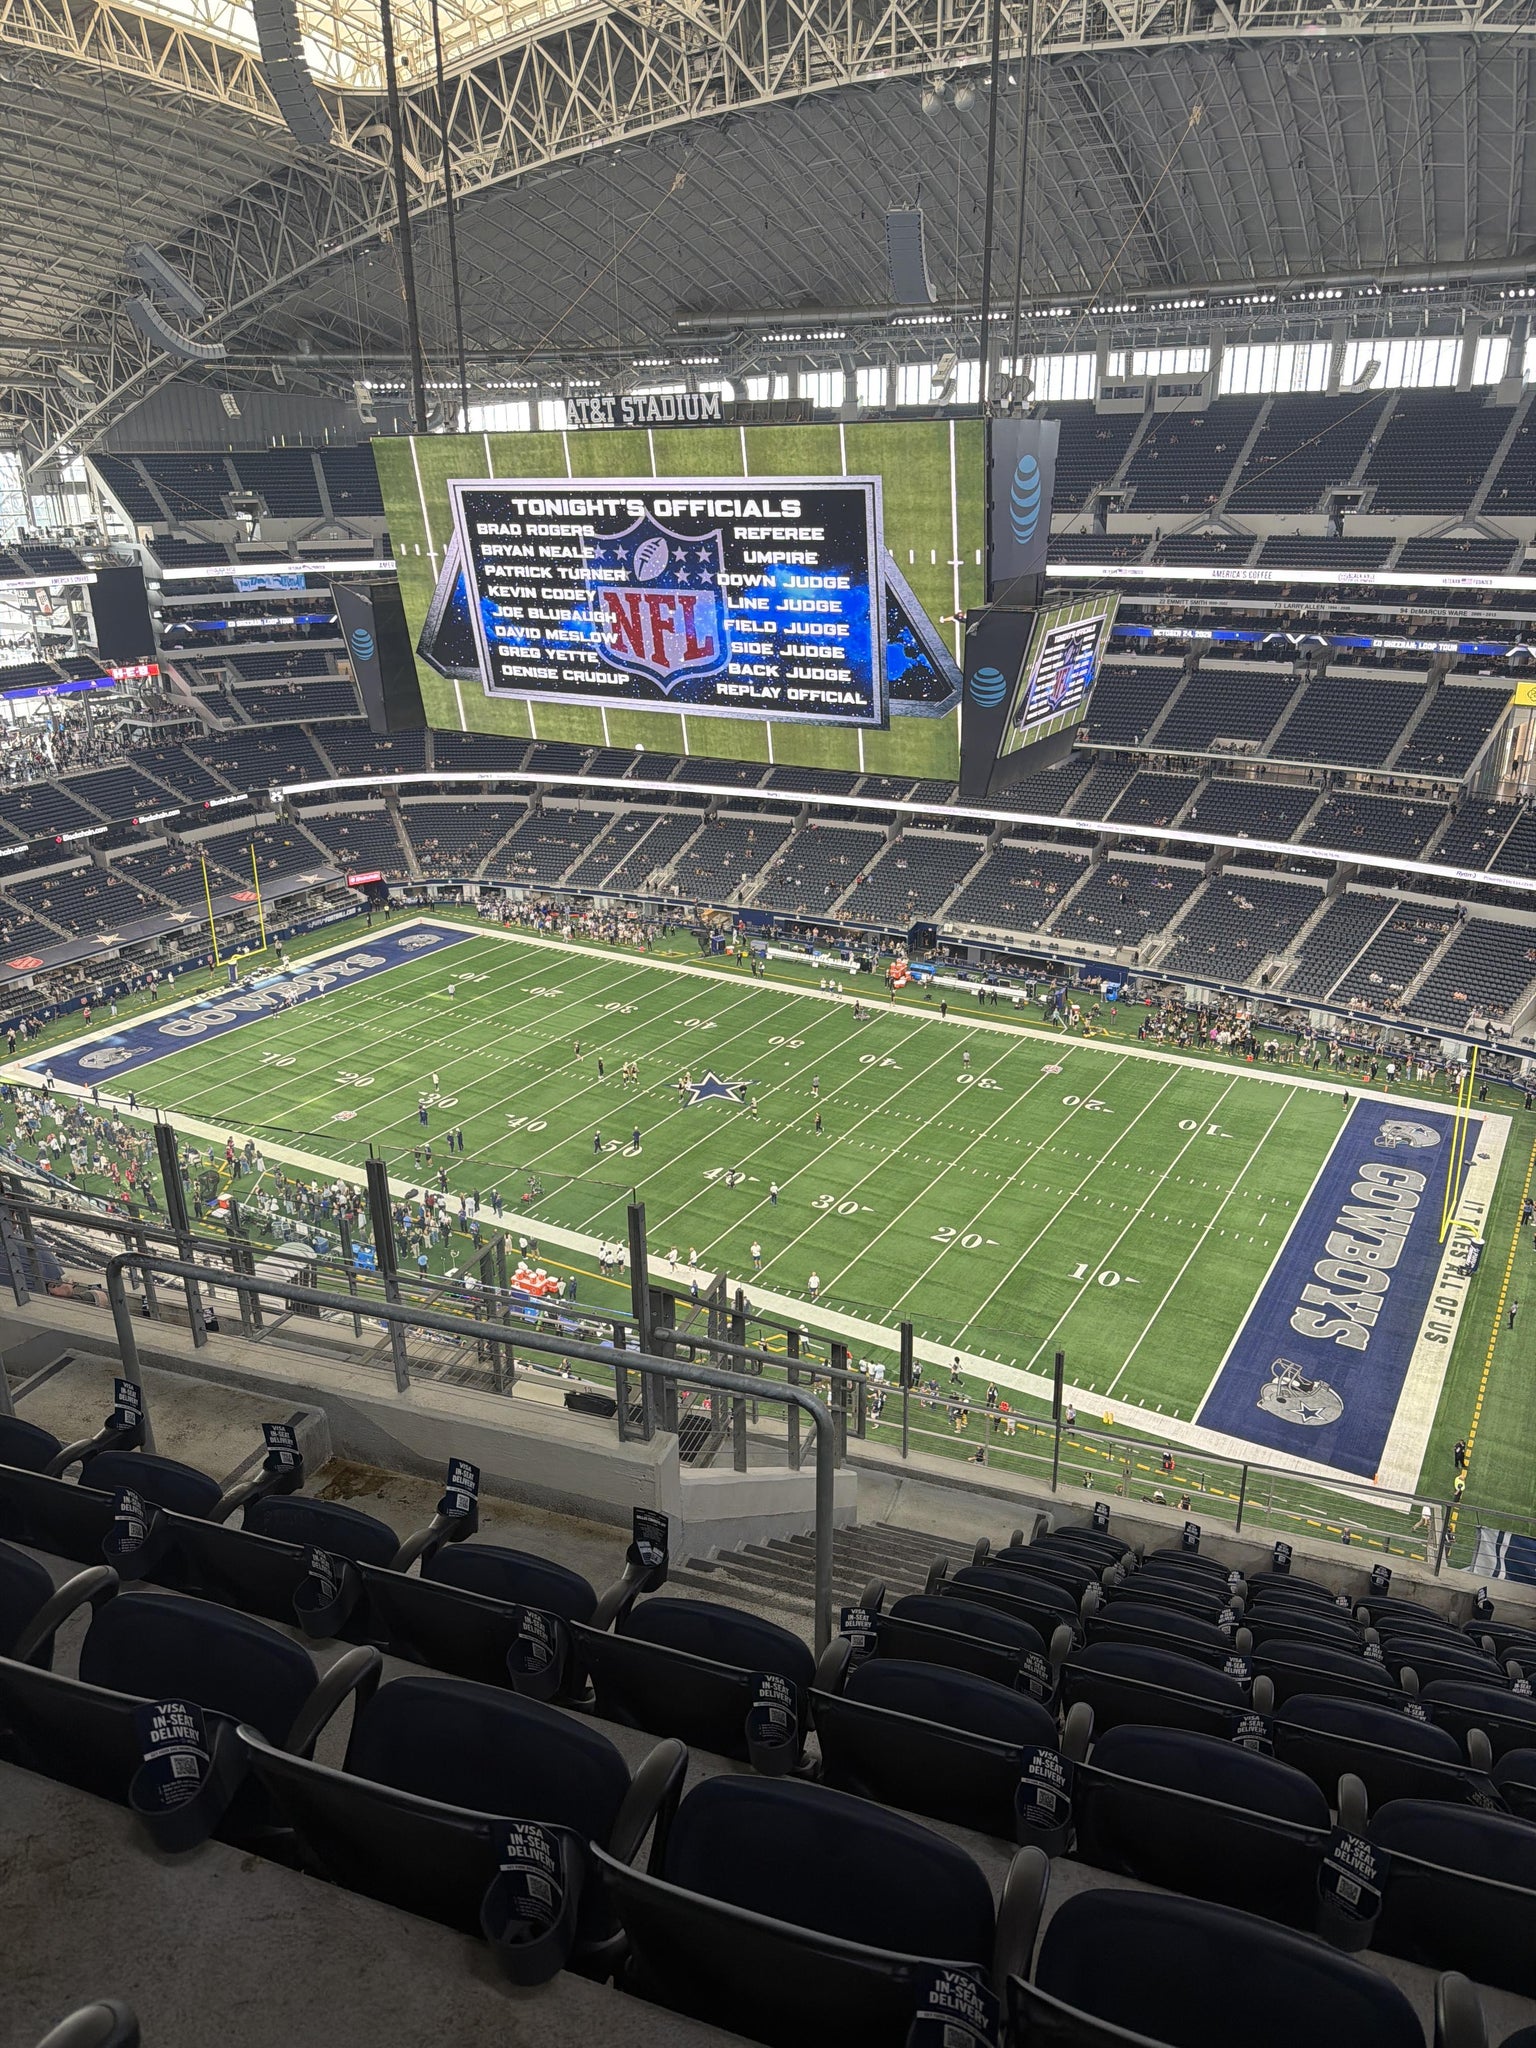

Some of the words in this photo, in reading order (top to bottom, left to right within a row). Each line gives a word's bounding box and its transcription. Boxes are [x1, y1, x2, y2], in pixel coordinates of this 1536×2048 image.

[567, 397, 616, 424] AT&T
[621, 393, 722, 423] STADIUM
[511, 498, 646, 517] TONIGHT'S
[653, 498, 802, 518] OFFICIALS
[477, 523, 521, 536] BRAD
[526, 524, 595, 537] ROGERS
[734, 526, 825, 541] REFEREE
[480, 544, 534, 557] BRYAN
[539, 545, 595, 559] NEALE
[743, 550, 819, 565] UMPIRE
[484, 565, 553, 579] PATRICK
[557, 567, 628, 582] TURNER
[717, 573, 776, 588] DOWN
[783, 576, 851, 590] JUDGE
[1249, 570, 1273, 580] COFFEE
[487, 585, 538, 599] KEVIN
[541, 587, 597, 601] CODEY
[727, 597, 770, 610] LINE
[776, 599, 843, 613] JUDGE
[1190, 599, 1208, 607] SMITH
[492, 606, 523, 619] JOE
[527, 608, 618, 624] BLUBAUGH
[1448, 609, 1468, 617] WARE
[494, 625, 542, 640] DAVID
[545, 627, 619, 644] MESLOW
[602, 591, 715, 669] NFL
[723, 619, 776, 633] FIELD
[783, 622, 850, 637] JUDGE
[1153, 629, 1181, 638] OCTOBER
[498, 645, 541, 659] GREG
[545, 648, 599, 663] YETTE
[730, 641, 774, 655] SIDE
[780, 644, 846, 659] JUDGE
[1418, 642, 1437, 651] LOOP
[1438, 643, 1458, 652] TOUR
[502, 664, 559, 680] DENISE
[562, 670, 630, 685] CRUDUP
[728, 662, 780, 678] BACK
[785, 666, 852, 682] JUDGE
[716, 683, 781, 699] REPLAY
[787, 688, 868, 705] OFFICIAL
[159, 953, 386, 1037] COWBOYS
[1062, 1095, 1107, 1111] 20
[1178, 1119, 1223, 1136] 10
[811, 1194, 861, 1216] 30
[1462, 1200, 1485, 1215] IT
[930, 1226, 984, 1250] 20
[1290, 1163, 1427, 1351] COWBOYS
[1067, 1263, 1121, 1288] 10
[1433, 1296, 1459, 1318] OF
[1424, 1320, 1453, 1345] US
[269, 1436, 294, 1445] DELIVERY
[459, 1462, 472, 1472] VISA
[452, 1474, 476, 1489] DELIVERY
[845, 1620, 872, 1628] DELIVERY
[848, 1614, 870, 1622] IN-SEAT
[761, 1681, 790, 1695] IN-SEAT
[764, 1674, 785, 1685] VISA
[759, 1688, 793, 1706] DELIVERY
[155, 1703, 187, 1715] VISA
[152, 1713, 194, 1729] IN-SEAT
[1239, 1720, 1265, 1728] IN-SEAT
[150, 1725, 200, 1743] DELIVERY
[1237, 1727, 1268, 1735] DELIVERY
[1032, 1756, 1064, 1775] IN-SEAT
[1037, 1749, 1059, 1764] VISA
[1028, 1764, 1066, 1787] DELIVERY
[512, 1823, 544, 1839] VISA
[510, 1833, 551, 1856] IN-SEAT
[1347, 1834, 1372, 1854] VISA
[507, 1845, 555, 1872] DELIVERY
[1340, 1840, 1377, 1867] IN-SEAT
[1333, 1847, 1378, 1879] DELIVERY
[942, 1970, 977, 1993] VISA
[935, 1979, 985, 2012] IN-SEAT
[929, 1990, 989, 2029] DELIVERY
